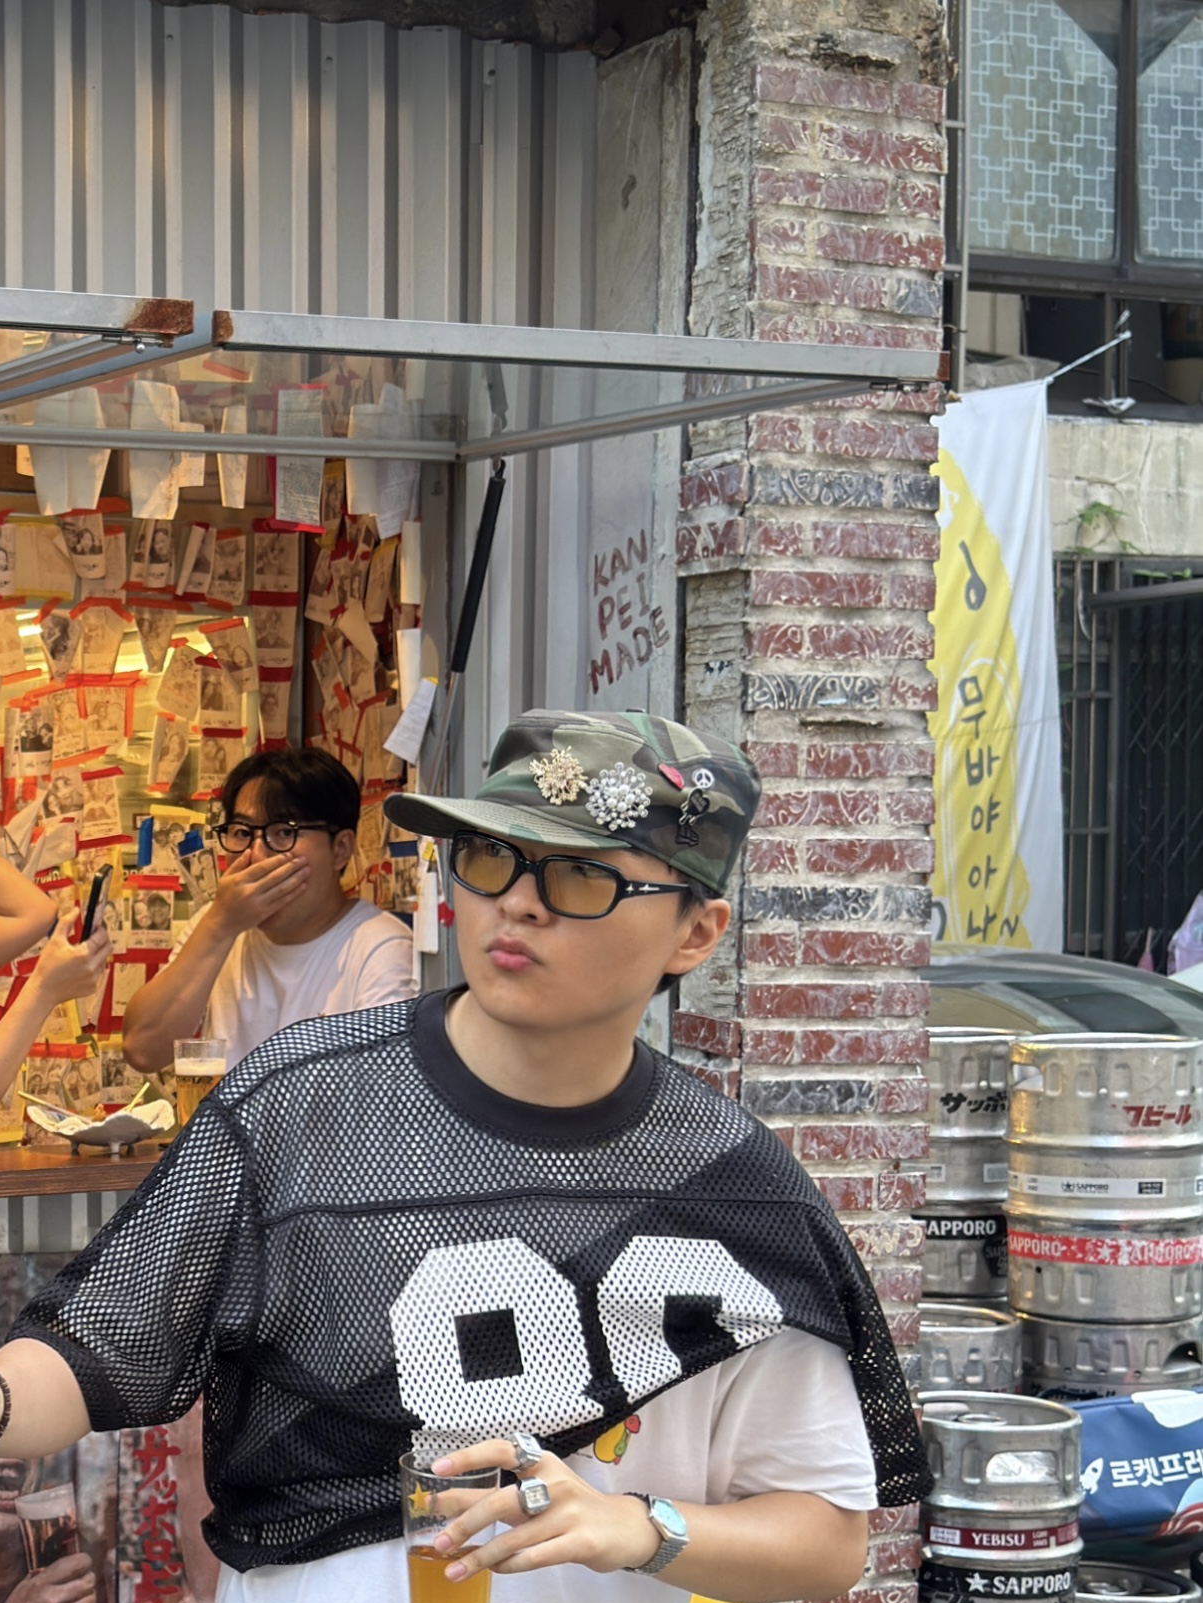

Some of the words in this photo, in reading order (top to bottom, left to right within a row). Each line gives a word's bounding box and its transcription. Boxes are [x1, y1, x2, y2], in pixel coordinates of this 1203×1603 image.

[593, 528, 647, 598] KAN
[598, 572, 651, 641] PEI
[589, 605, 671, 695] MADE
[971, 1532, 1027, 1547] YEBISU
[992, 1571, 1071, 1595] SAPPORO
